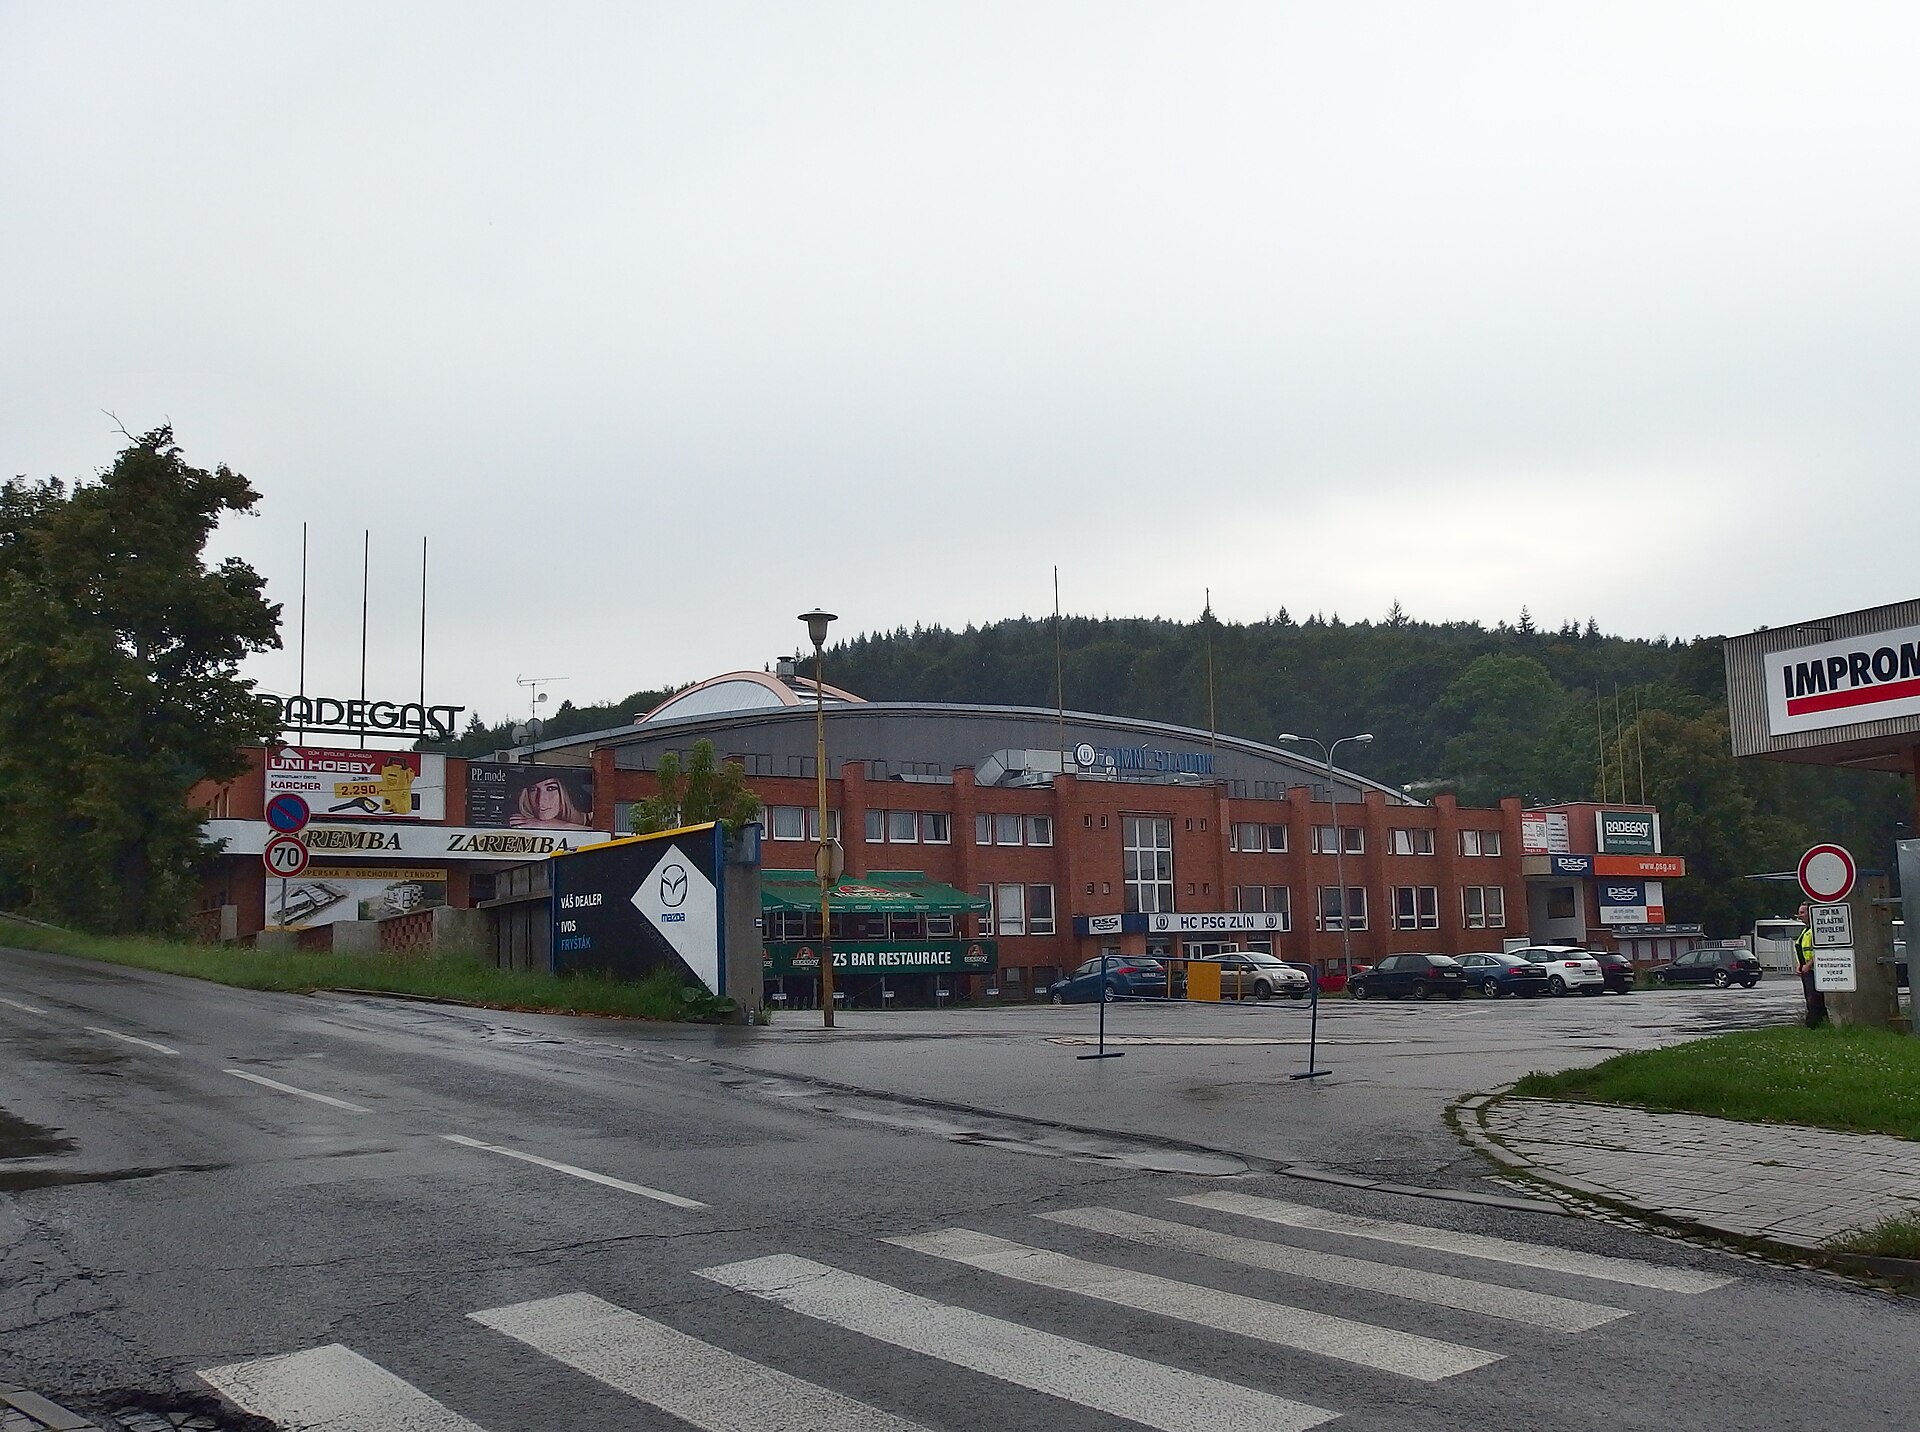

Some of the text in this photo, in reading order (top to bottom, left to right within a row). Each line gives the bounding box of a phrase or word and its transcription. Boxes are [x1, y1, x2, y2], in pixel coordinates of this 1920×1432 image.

[271, 759, 376, 773] UNI HOBBY
[485, 769, 506, 782] mode
[271, 781, 321, 790] KARCHER
[1606, 821, 1649, 838] RADEGAST
[264, 829, 402, 851] ZREMBA
[446, 834, 568, 854] ZAREMBA
[274, 847, 299, 867] 70
[1639, 862, 1677, 873] www.psg.eu
[560, 893, 602, 909] VÁŠ DEALER
[560, 920, 577, 933] IVOS
[1180, 913, 1255, 929] HC PSG ZLÍN
[561, 935, 592, 951] FRYŠTÁK
[832, 951, 952, 967] ZS BAR RESTAURACE
